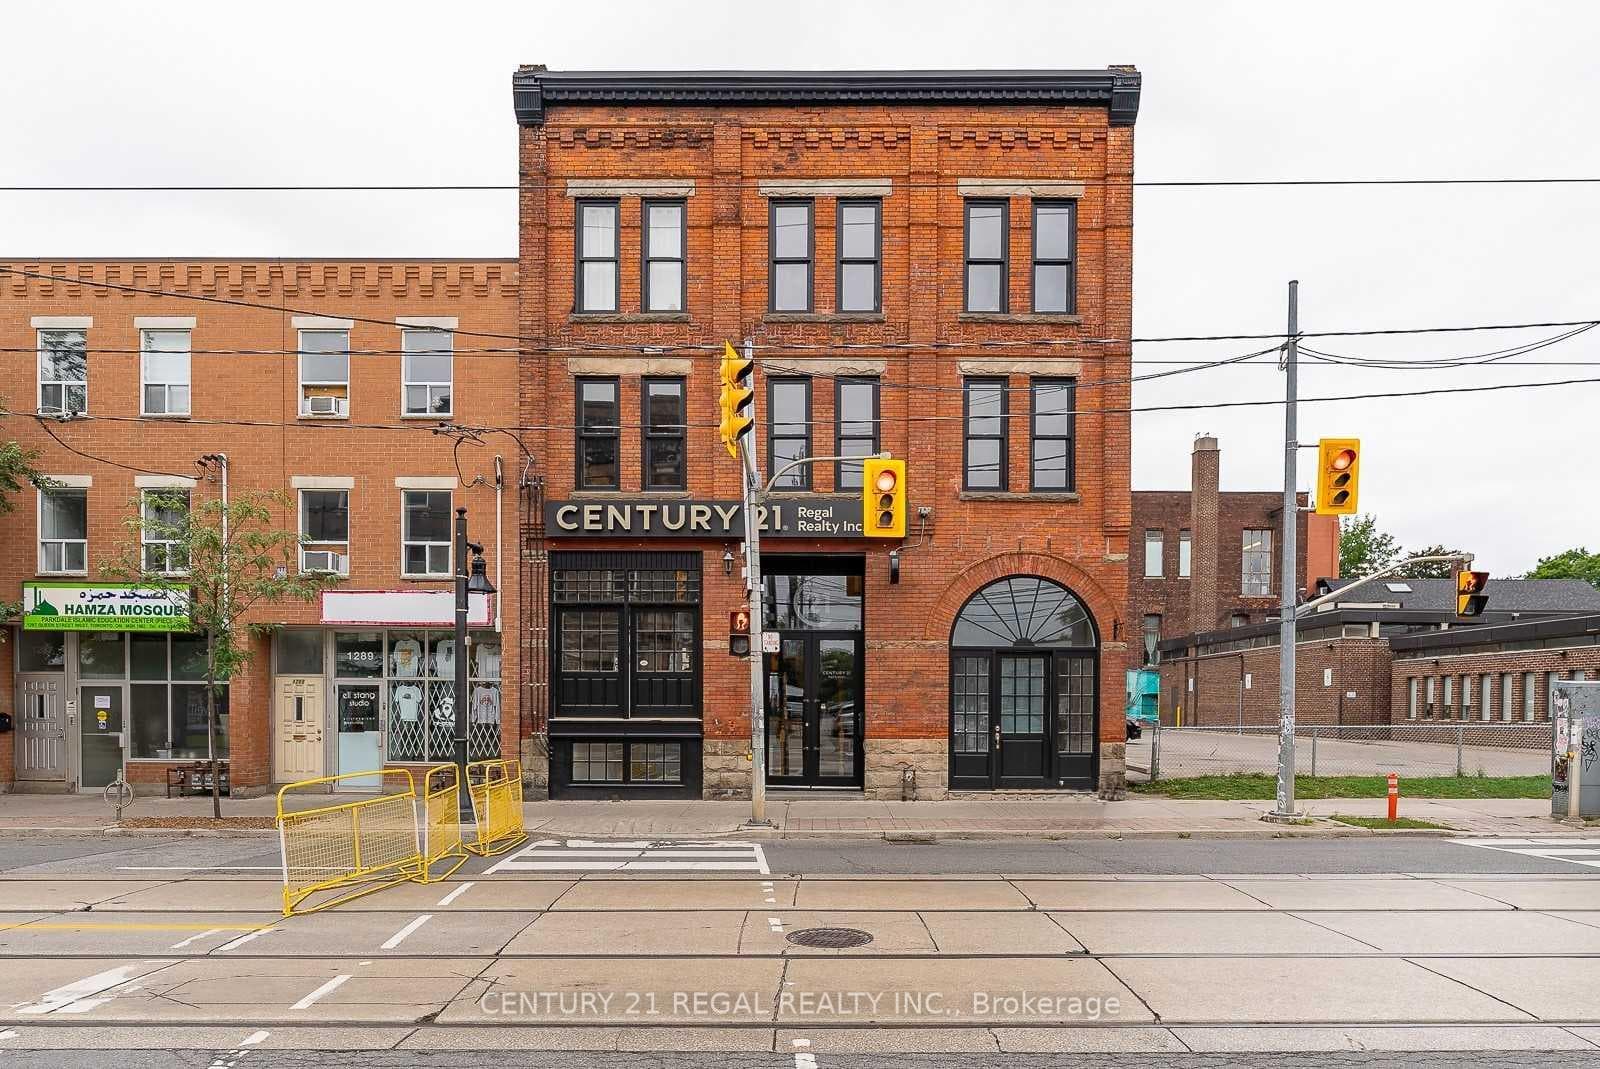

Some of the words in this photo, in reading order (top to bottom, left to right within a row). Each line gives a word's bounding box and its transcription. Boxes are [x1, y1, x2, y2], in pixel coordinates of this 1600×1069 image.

[556, 504, 740, 531] CENTURY
[798, 506, 833, 521] Regal
[798, 520, 839, 534] Realty
[64, 604, 116, 615] HAMZA
[120, 604, 184, 616] MOSQUE
[346, 651, 374, 660] 1289
[349, 699, 370, 707] studio
